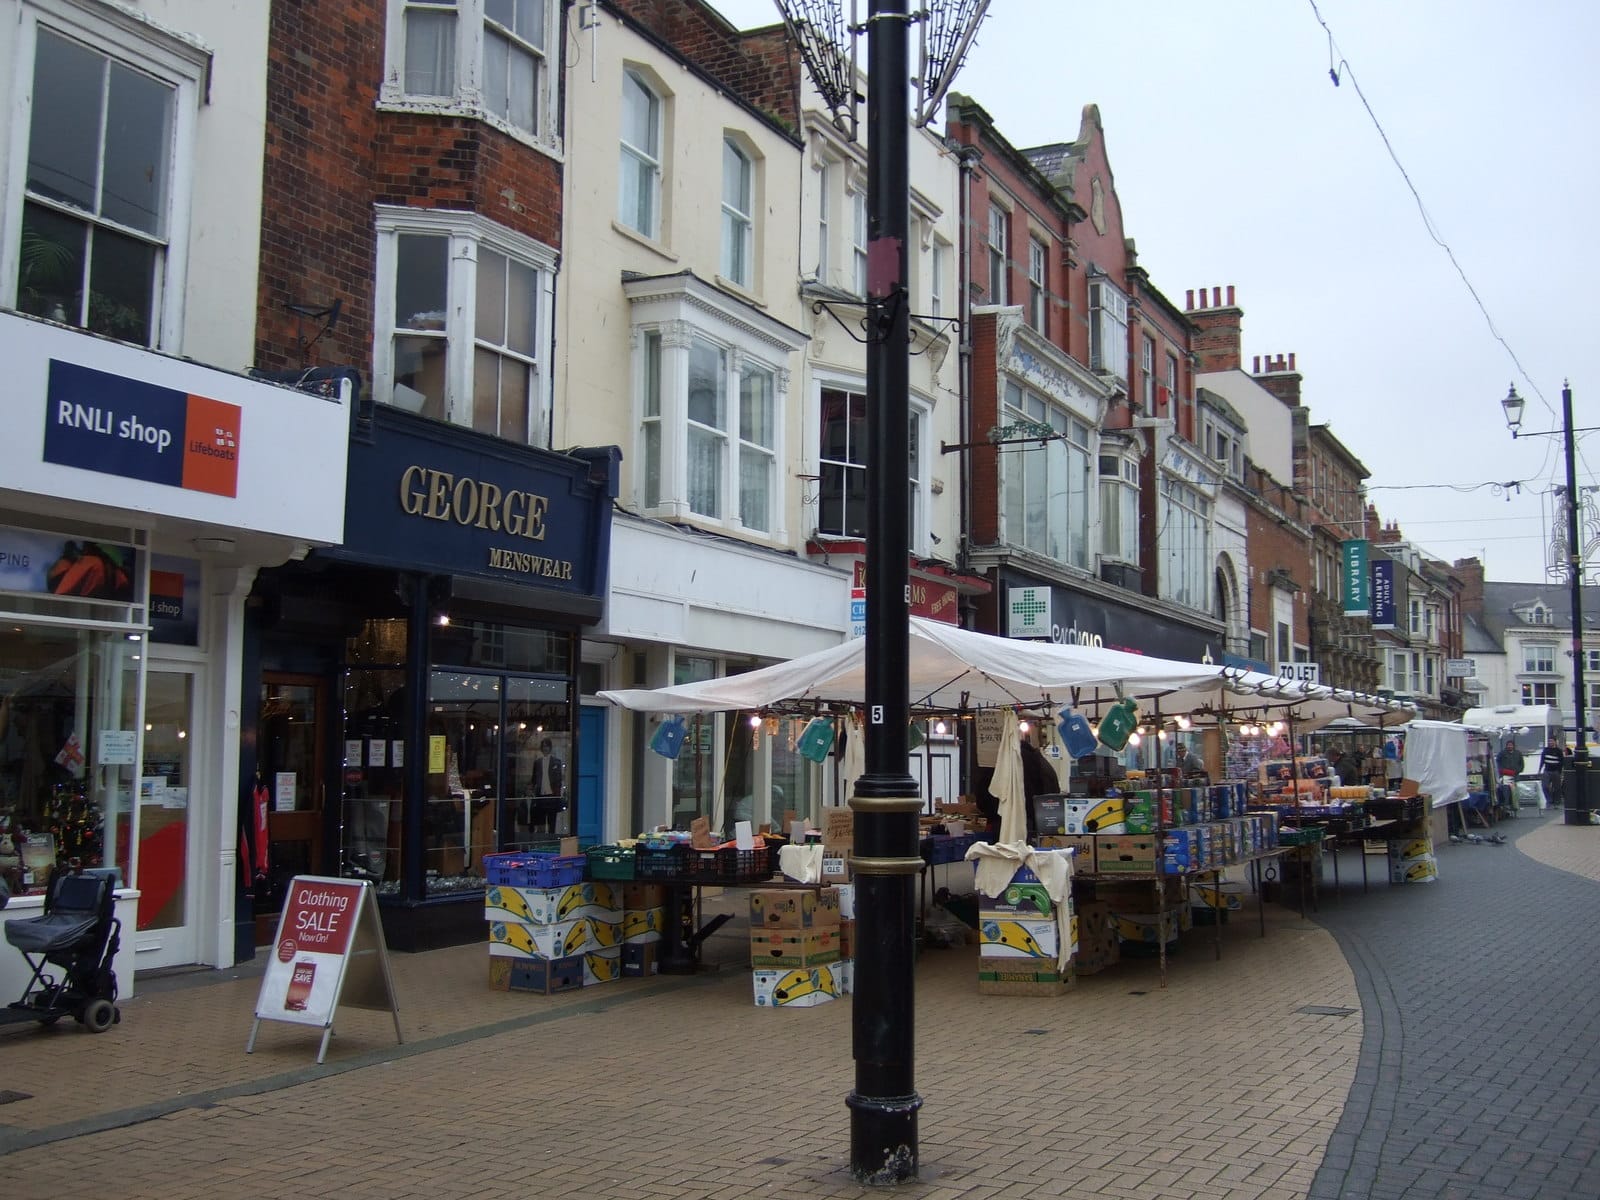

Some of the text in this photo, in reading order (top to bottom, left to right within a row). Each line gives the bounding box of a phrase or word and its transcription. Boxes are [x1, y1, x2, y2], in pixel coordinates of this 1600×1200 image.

[57, 399, 172, 454] RNLI shop
[189, 440, 236, 461] Lifeboats
[400, 465, 549, 541] GEORGE
[0, 552, 31, 568] PING
[488, 547, 573, 580] MENSWEAR
[1350, 546, 1361, 602] LIBRARY
[1375, 566, 1383, 618] LEARNING
[156, 601, 181, 617] shop
[930, 598, 943, 615] FREE
[1280, 665, 1316, 681] TO LET
[298, 889, 349, 911] Clothing
[295, 910, 341, 932] SALE
[298, 932, 329, 943] Now On!
[294, 973, 313, 983] SAVE
